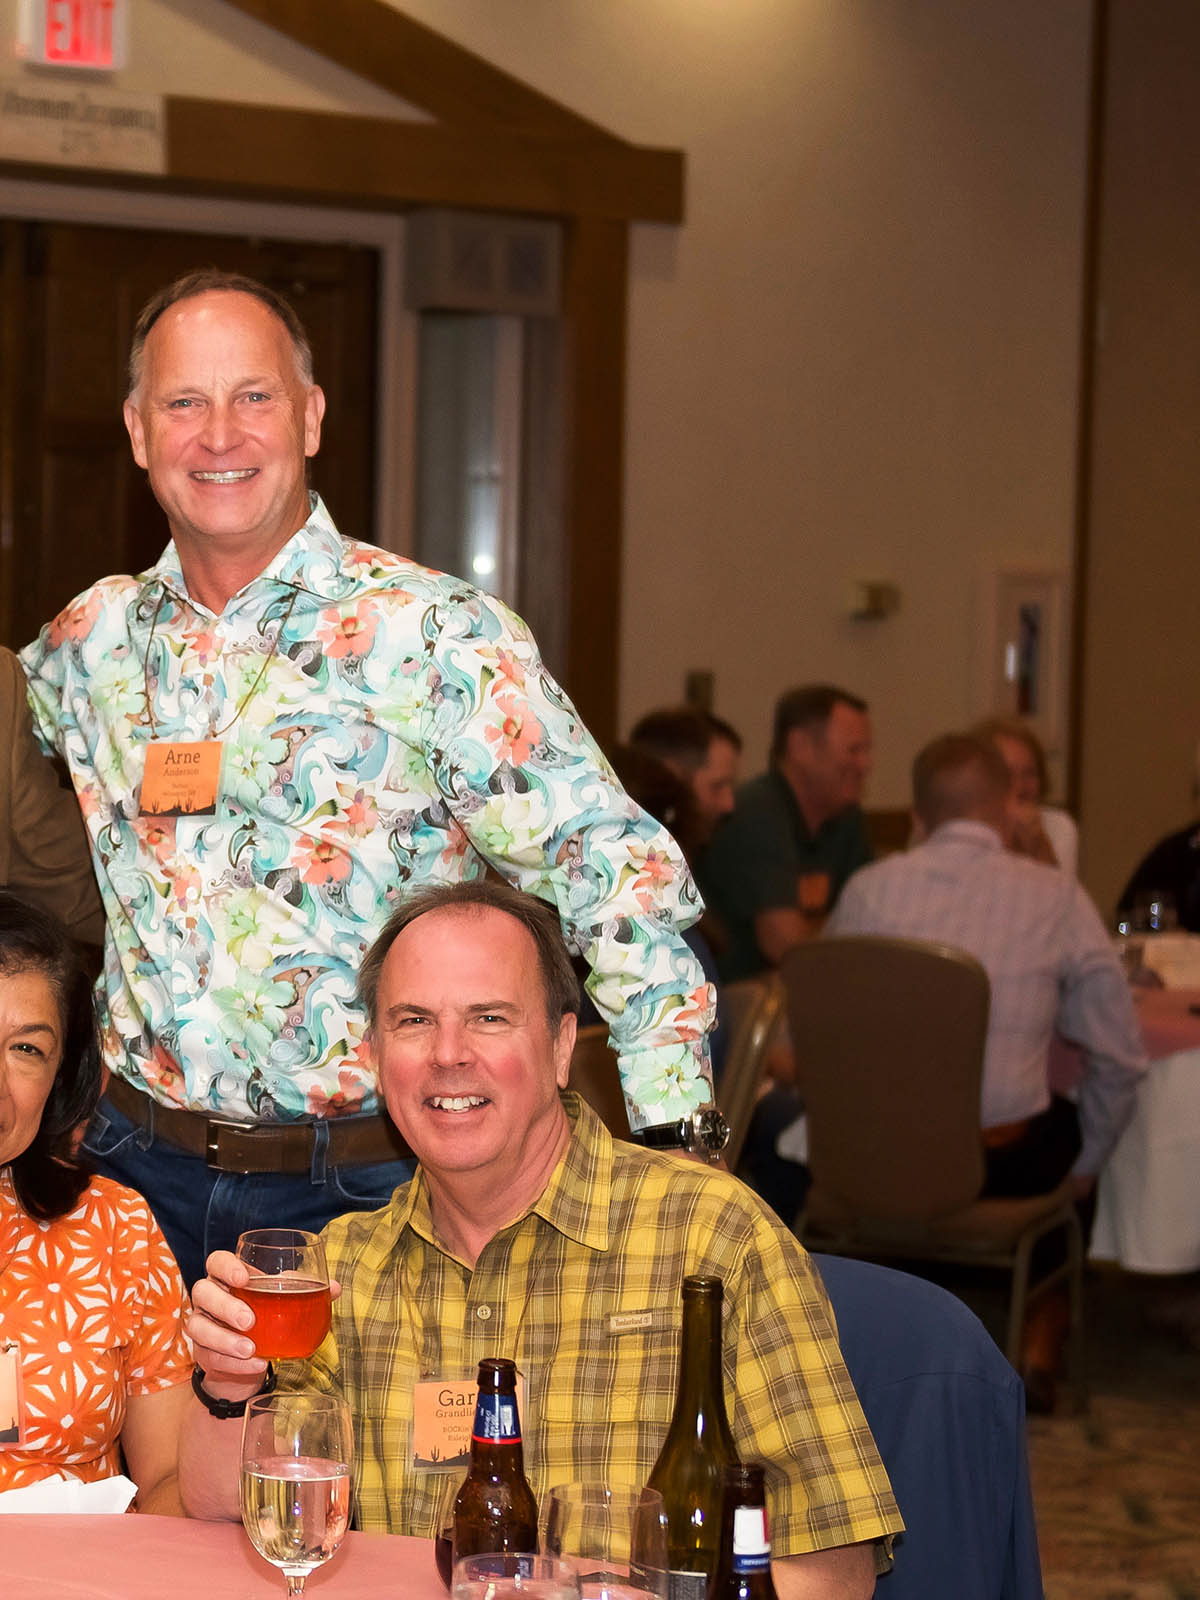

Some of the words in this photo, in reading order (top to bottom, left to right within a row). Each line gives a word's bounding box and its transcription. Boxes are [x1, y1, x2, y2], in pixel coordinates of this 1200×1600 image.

[45, 0, 114, 64] EXIT
[164, 749, 201, 765] Arne
[438, 1389, 476, 1407] Gar
[435, 1408, 476, 1418] Grandli
